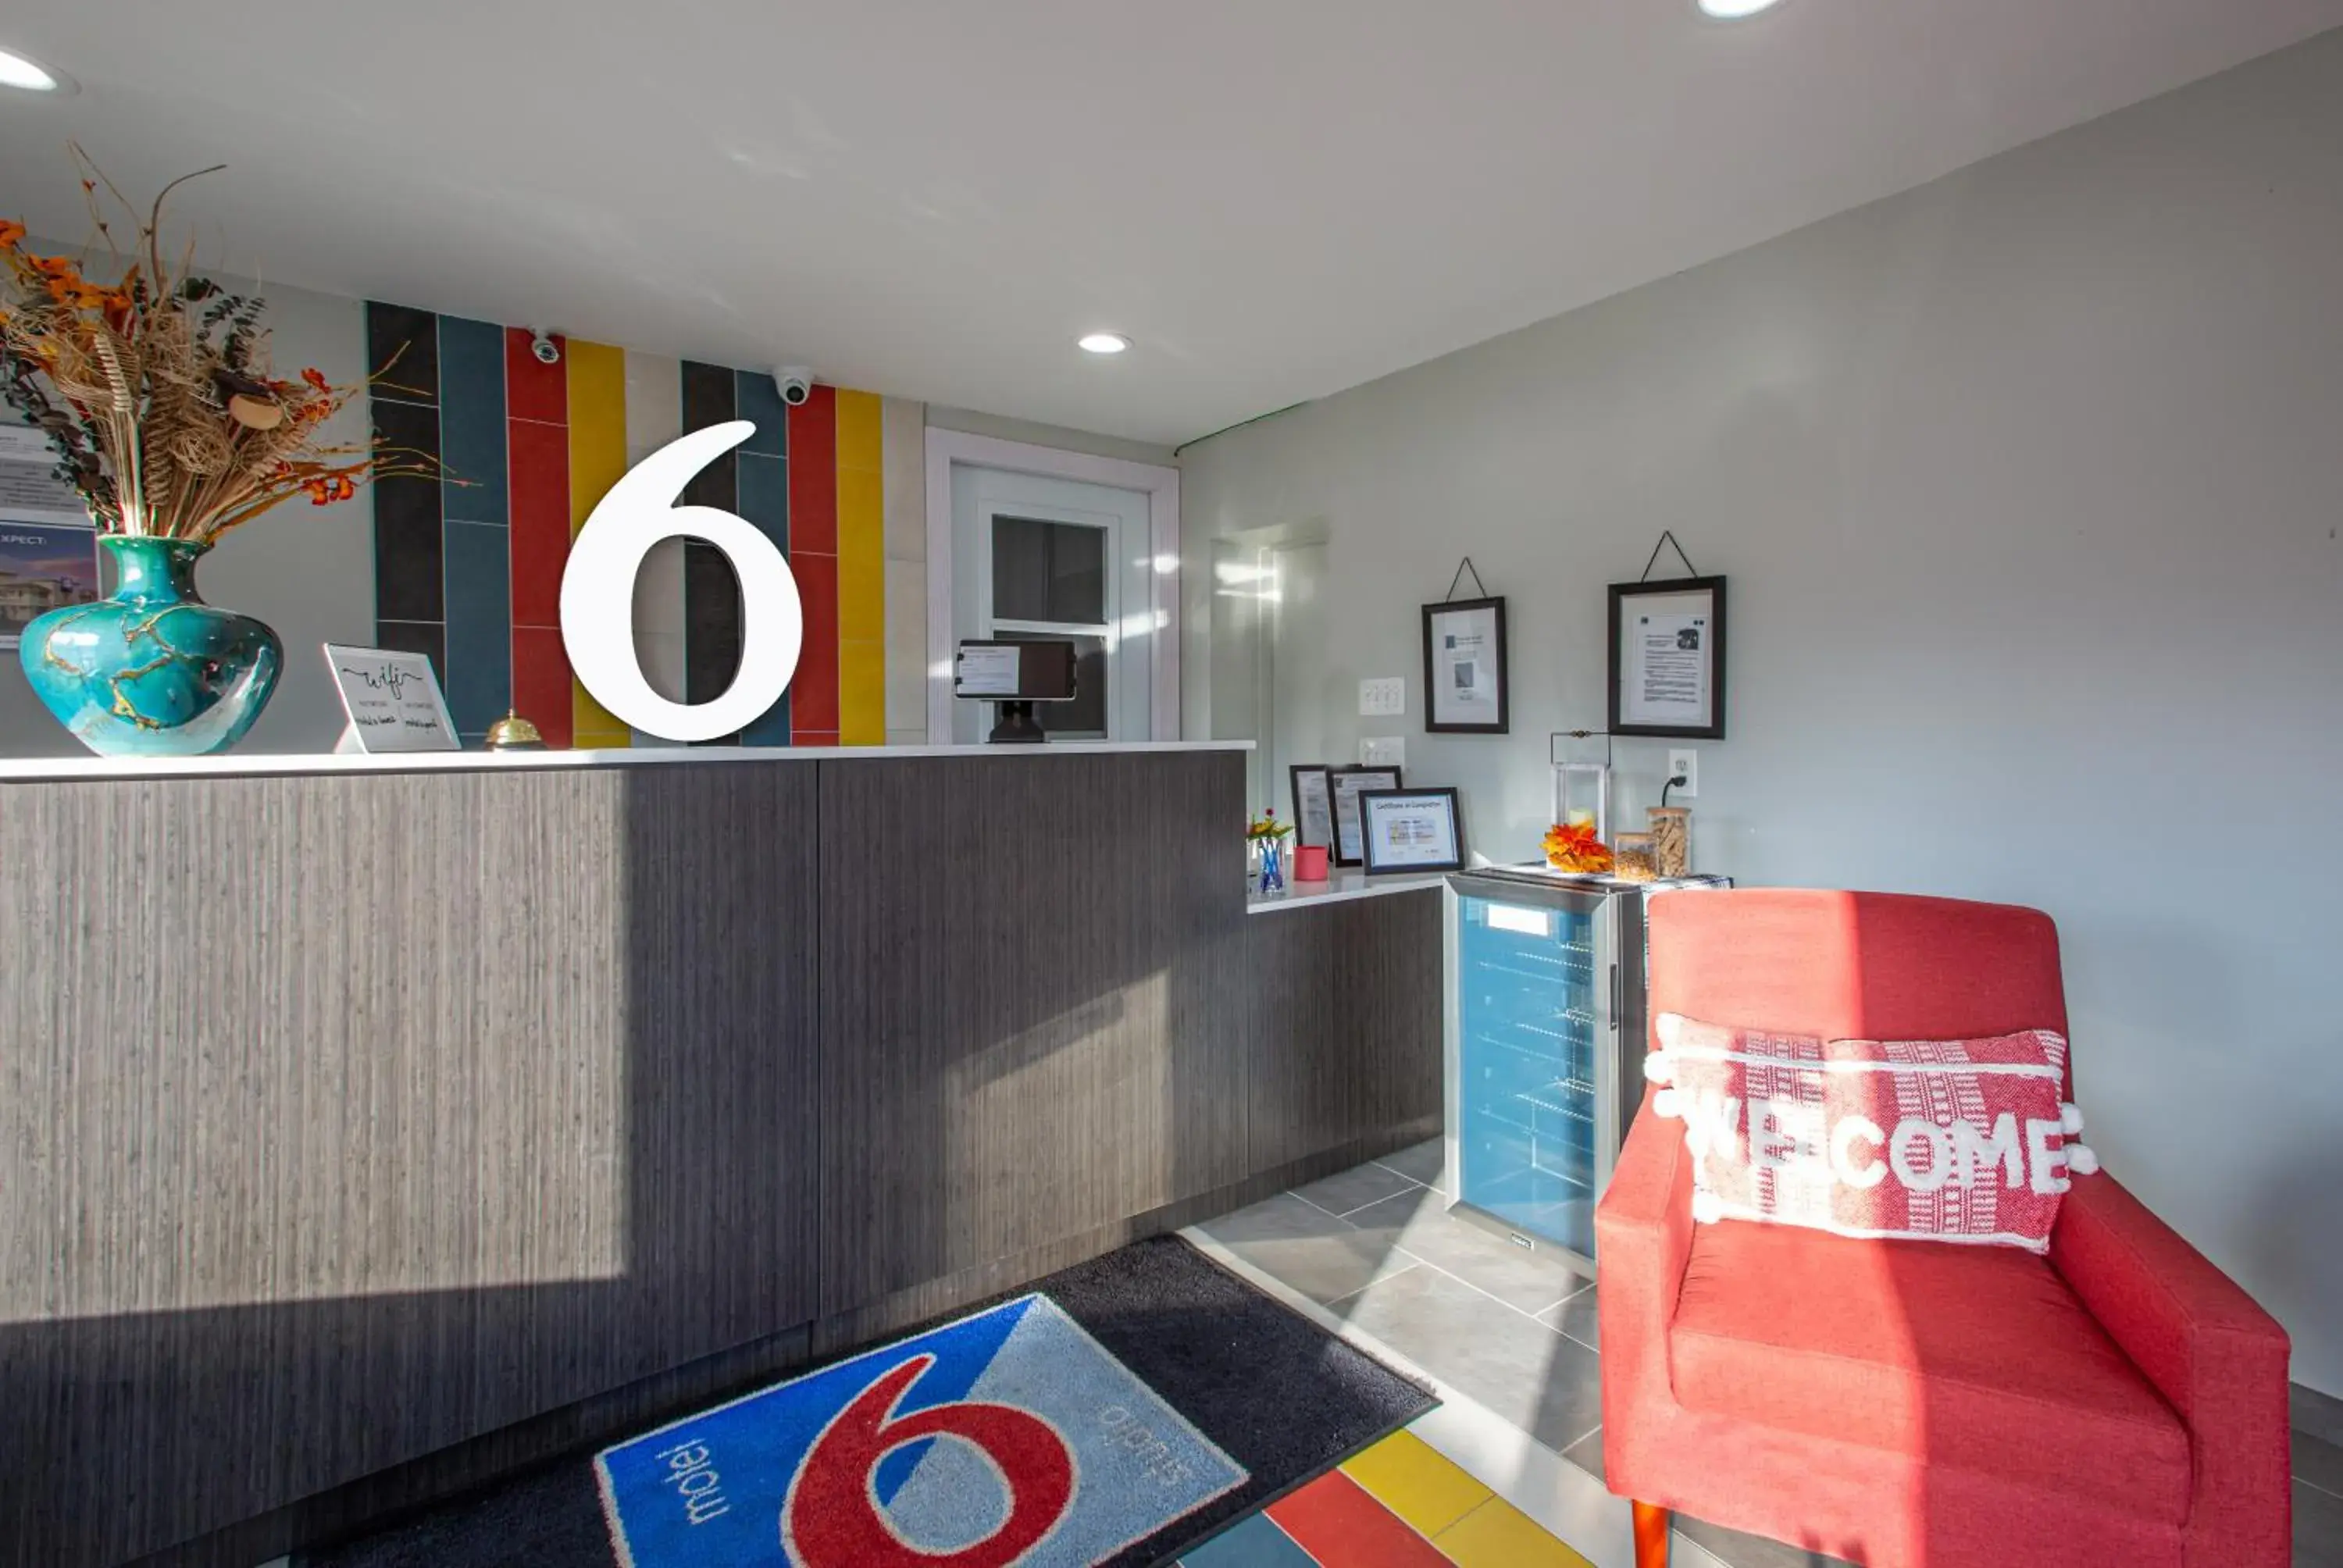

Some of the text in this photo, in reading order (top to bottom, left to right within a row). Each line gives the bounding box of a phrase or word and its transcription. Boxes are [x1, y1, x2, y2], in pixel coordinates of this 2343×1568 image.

[560, 420, 803, 742] 6
[342, 662, 423, 700] wifi
[654, 1438, 730, 1524] motel
[780, 1352, 1079, 1568] 6
